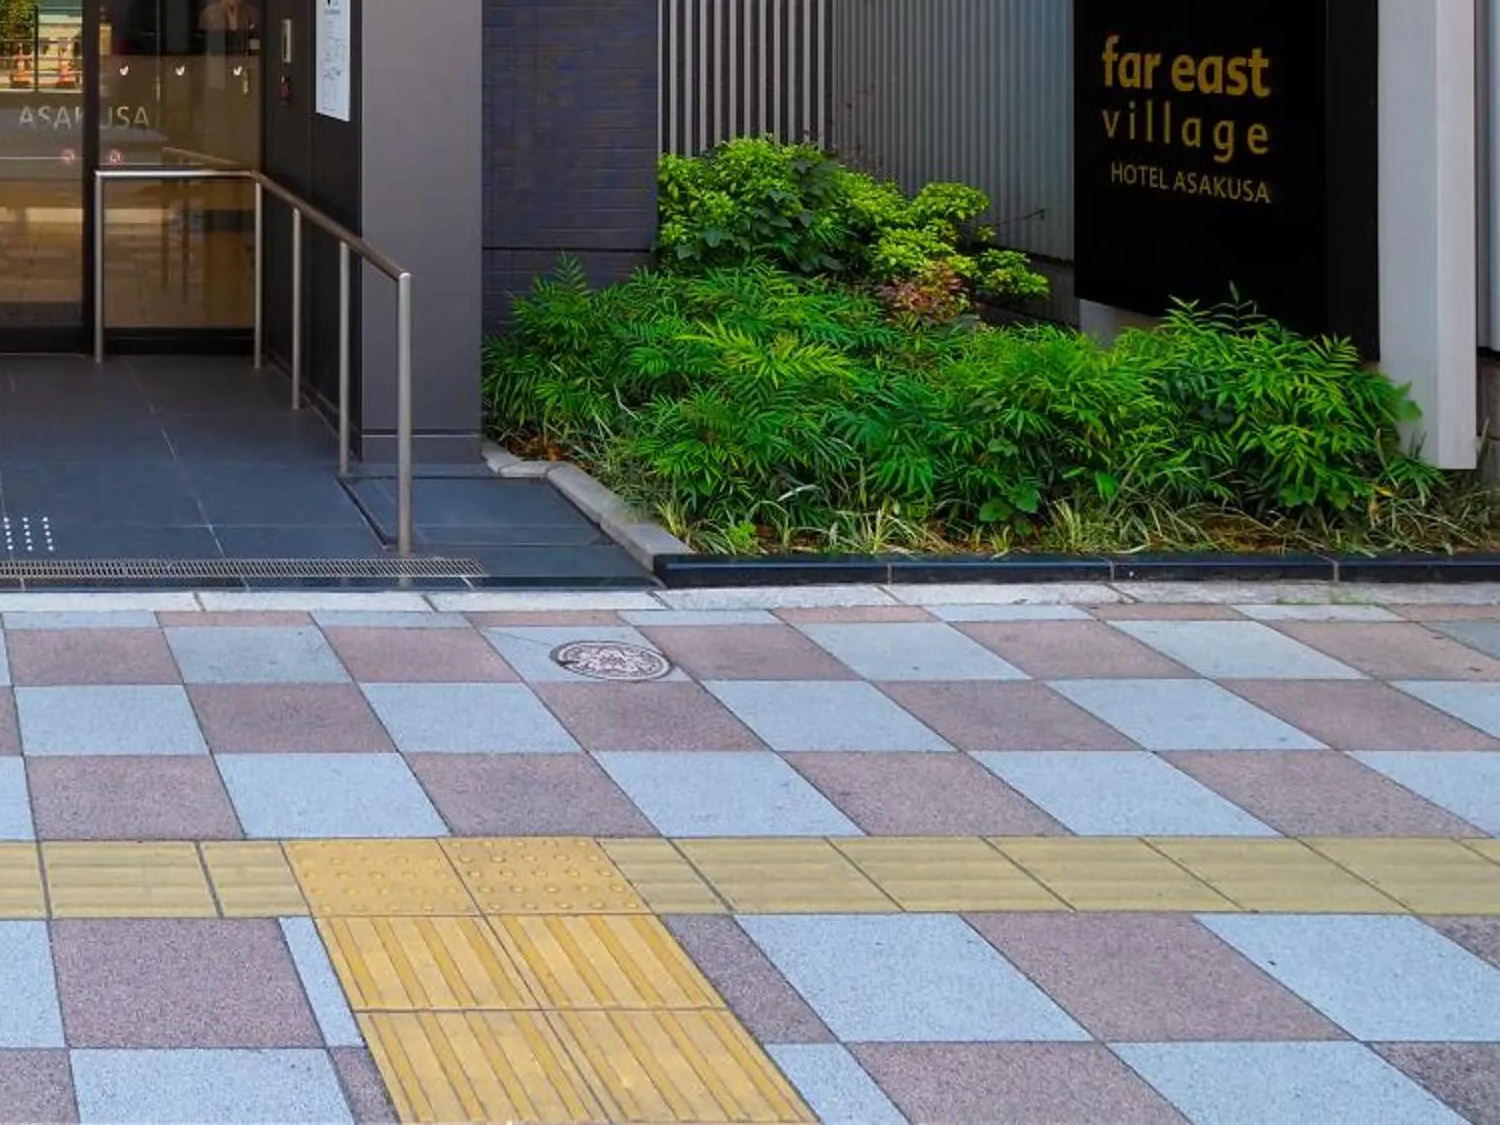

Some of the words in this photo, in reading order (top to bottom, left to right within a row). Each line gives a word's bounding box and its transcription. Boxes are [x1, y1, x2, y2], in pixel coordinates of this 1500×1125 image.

[1102, 34, 1162, 90] far
[1171, 47, 1272, 98] east
[1101, 98, 1269, 163] village
[1111, 161, 1169, 190] HOTEL
[1173, 170, 1272, 204] ASAKUSA
